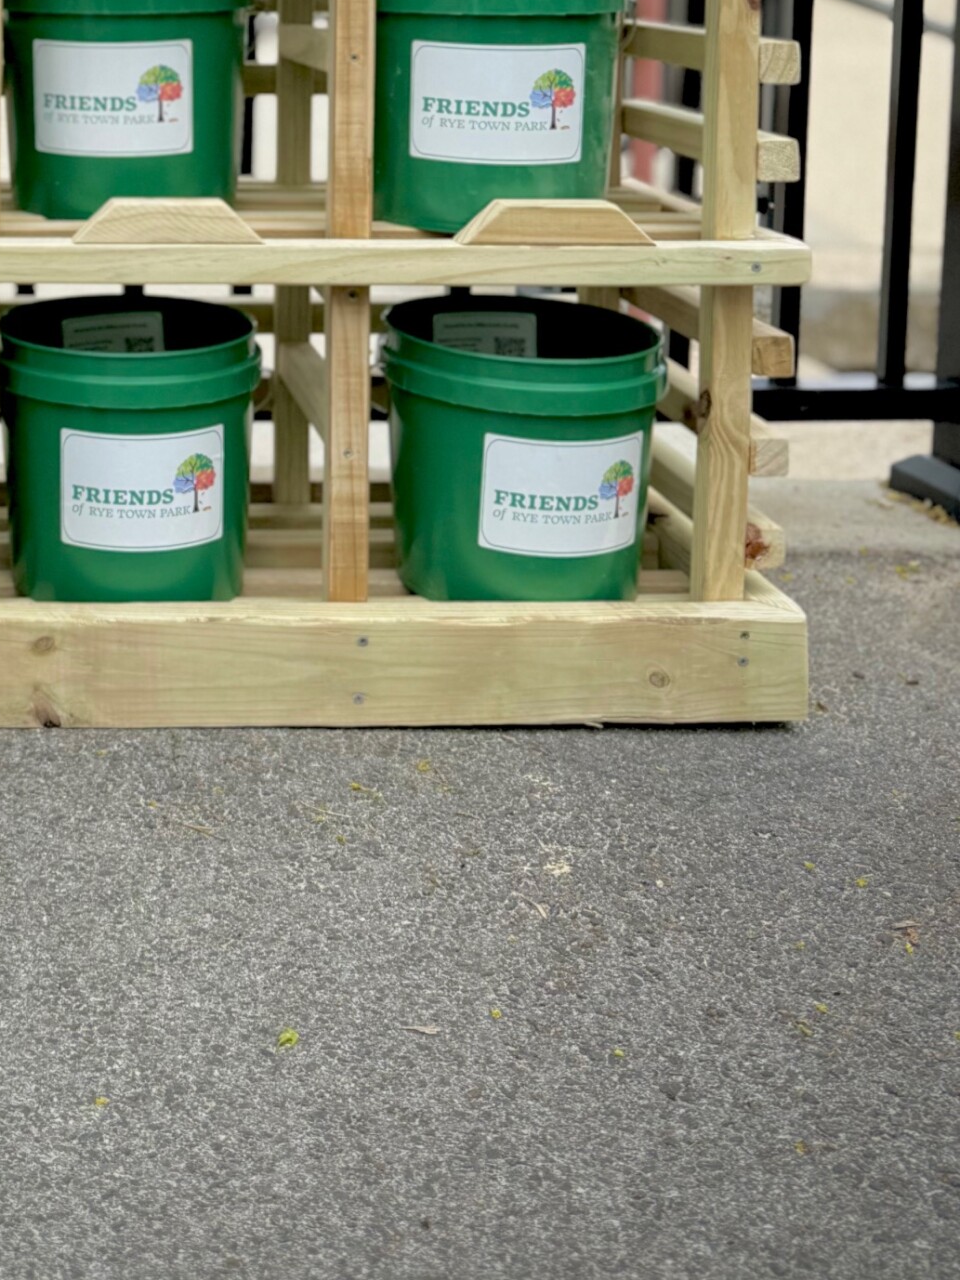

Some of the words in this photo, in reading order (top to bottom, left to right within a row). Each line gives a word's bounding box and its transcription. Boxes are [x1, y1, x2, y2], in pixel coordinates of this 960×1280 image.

[43, 93, 137, 112] FRIENDS
[422, 96, 530, 117] FRIENDS
[81, 114, 119, 125] TOWN
[123, 115, 155, 125] PARK
[421, 115, 435, 128] of
[439, 118, 466, 129] RYE
[469, 120, 510, 131] TOWN
[514, 121, 548, 131] PARK
[72, 484, 174, 505] FRIENDS
[494, 489, 599, 511] FRIENDS
[72, 502, 85, 516] of
[89, 507, 114, 518] RYE
[117, 508, 156, 519] TOWN
[160, 505, 191, 518] PARK
[493, 507, 507, 521] of
[512, 511, 538, 523] RYE
[542, 513, 581, 525] TOWN
[585, 511, 613, 524] PARK
